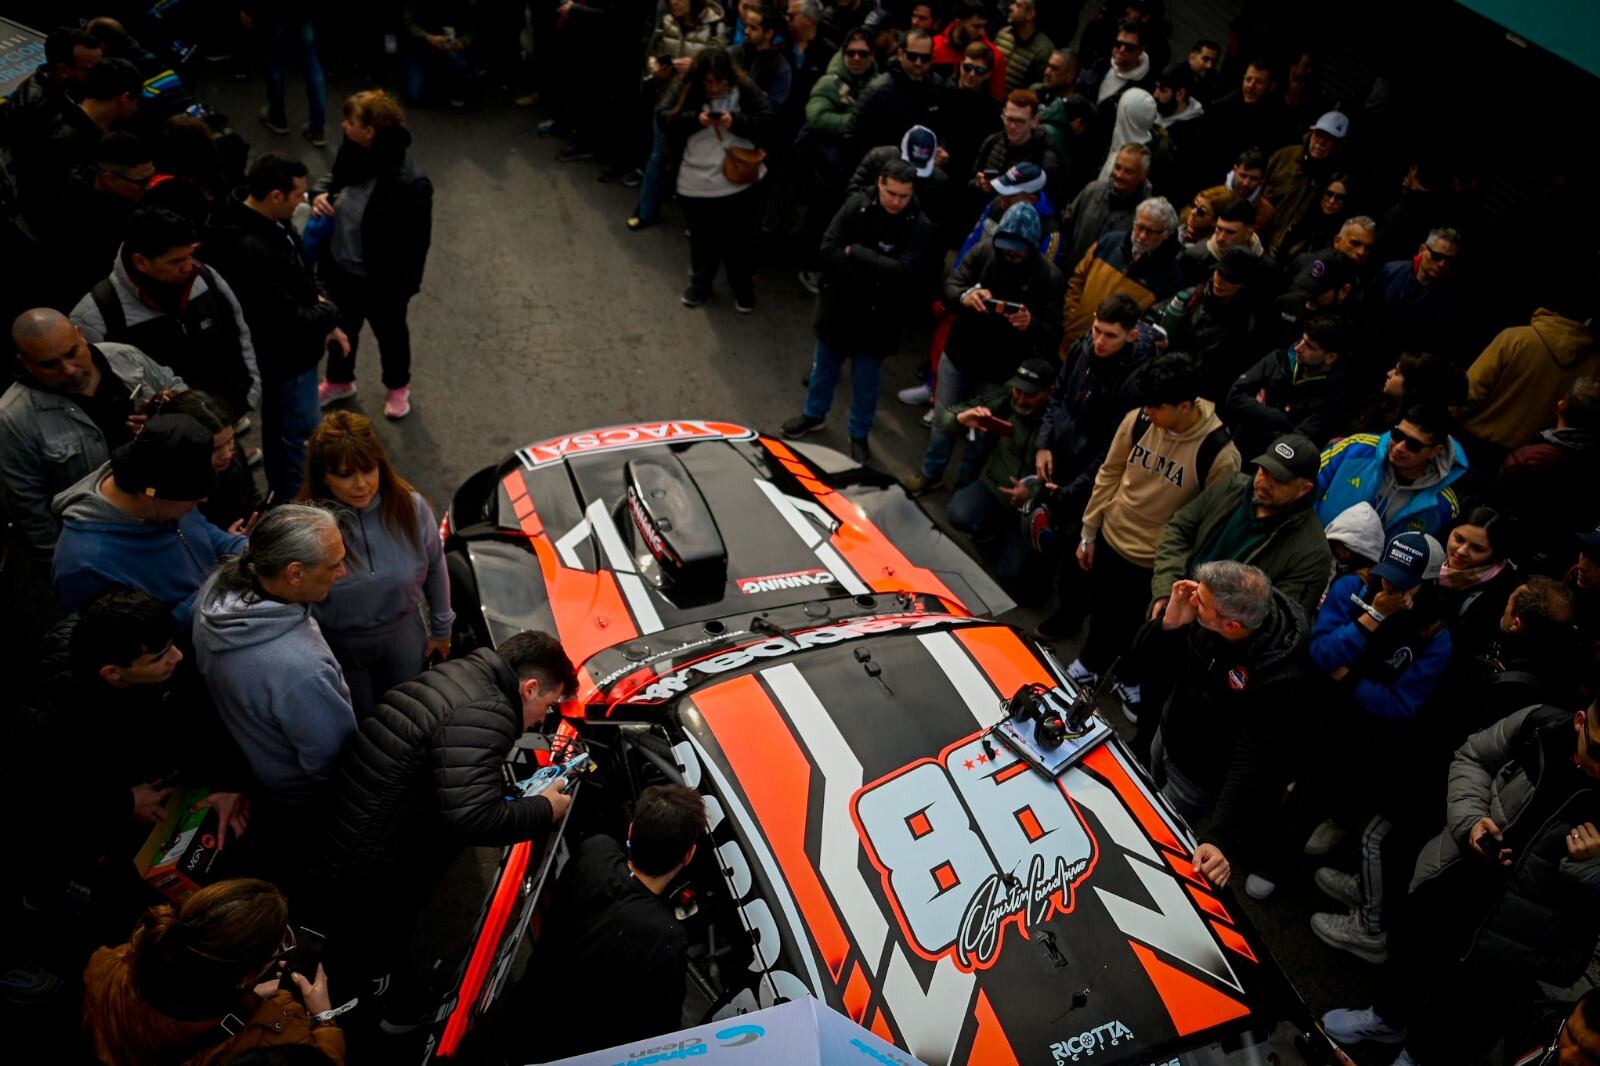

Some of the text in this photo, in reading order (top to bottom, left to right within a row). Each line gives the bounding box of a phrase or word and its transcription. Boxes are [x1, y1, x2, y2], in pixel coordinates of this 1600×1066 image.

[1129, 445, 1184, 488] PUMA
[742, 572, 834, 594] CANNING
[850, 728, 1097, 958] 86
[1048, 1019, 1132, 1060] RICOTTA
[1055, 1032, 1136, 1066] DESIGN
